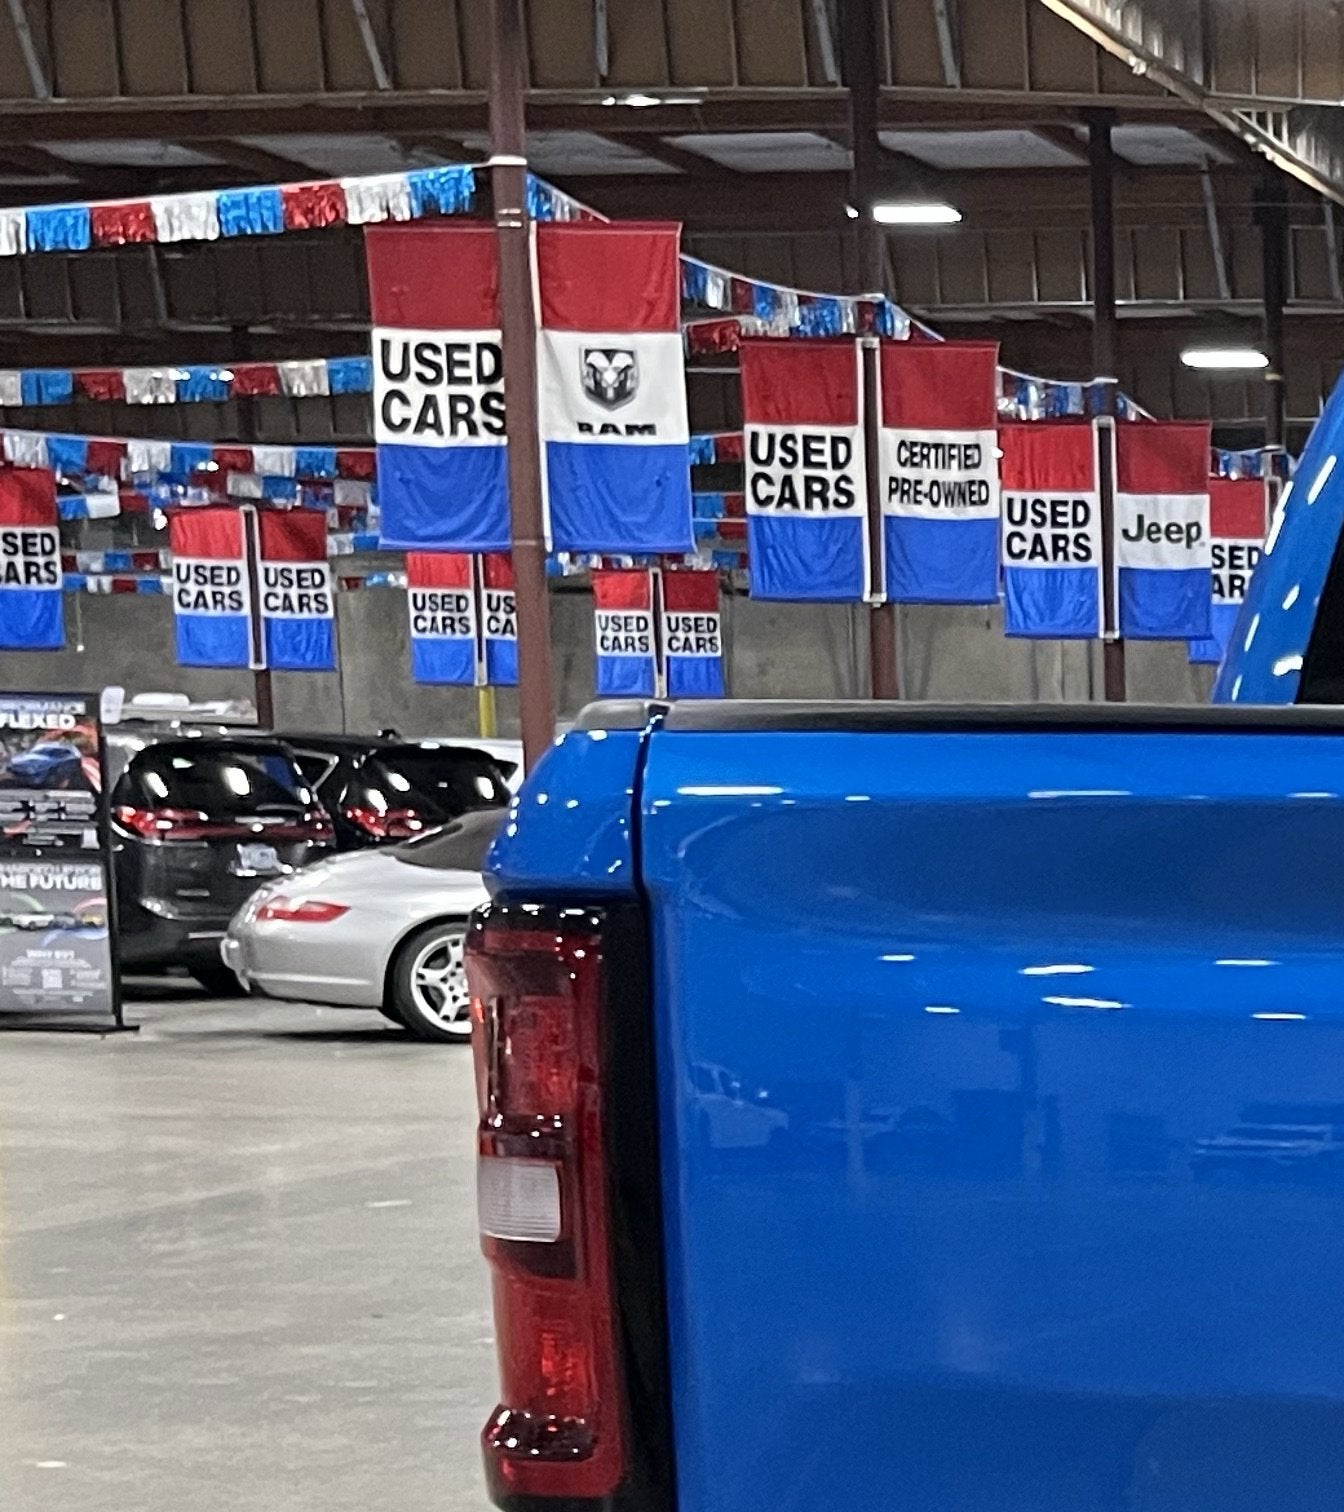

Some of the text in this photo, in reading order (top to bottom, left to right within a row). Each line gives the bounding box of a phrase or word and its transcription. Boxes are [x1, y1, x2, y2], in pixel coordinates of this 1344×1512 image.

[380, 339, 503, 387] USED
[381, 389, 506, 437] CARS
[750, 432, 852, 471] USED
[897, 440, 982, 471] CERTIFIED
[750, 472, 856, 511] CARS
[888, 476, 990, 508] PRE-OWNED
[1006, 497, 1091, 529] USED
[1122, 514, 1202, 549] Jeep
[1, 532, 56, 557] SED
[1005, 531, 1093, 562] CARS
[1211, 545, 1261, 569] SED
[0, 561, 58, 585] ARS
[176, 563, 241, 587] USED
[263, 568, 325, 590] USED
[1212, 574, 1245, 598] AR
[177, 589, 244, 610] CARS
[263, 592, 329, 614] CARS
[412, 593, 469, 613] USED
[487, 593, 516, 613] US
[413, 615, 471, 635] CARS
[486, 616, 515, 636] CA
[598, 614, 649, 633] USED
[666, 615, 718, 634] USED
[600, 634, 650, 653] CARS
[667, 636, 719, 654] CARS
